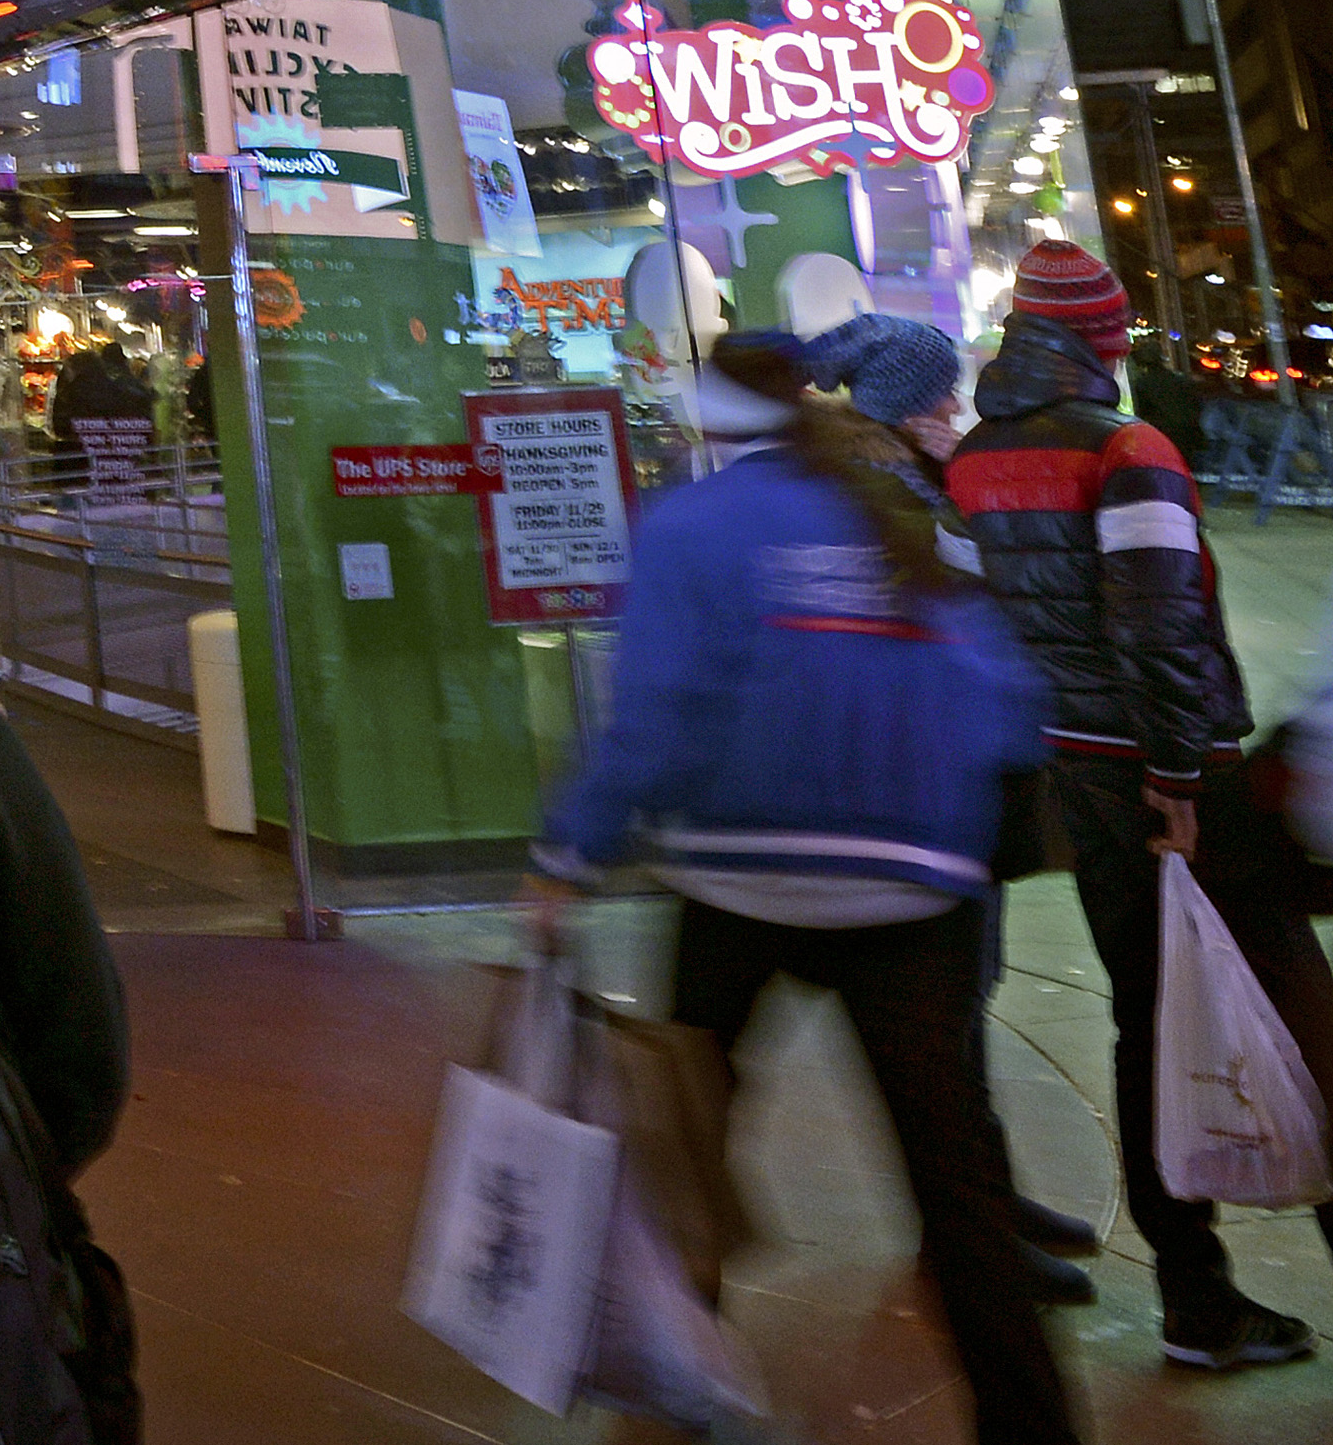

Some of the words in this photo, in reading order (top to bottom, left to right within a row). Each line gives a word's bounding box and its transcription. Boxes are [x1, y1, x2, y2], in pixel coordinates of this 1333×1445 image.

[496, 421, 546, 436] STORE
[551, 419, 603, 434] HOURS
[335, 457, 372, 478] The
[373, 456, 414, 478] UPS
[414, 457, 467, 477] Store
[513, 479, 566, 493] REOPEN
[514, 504, 561, 519] FRIDAY
[565, 501, 606, 516] 11/29
